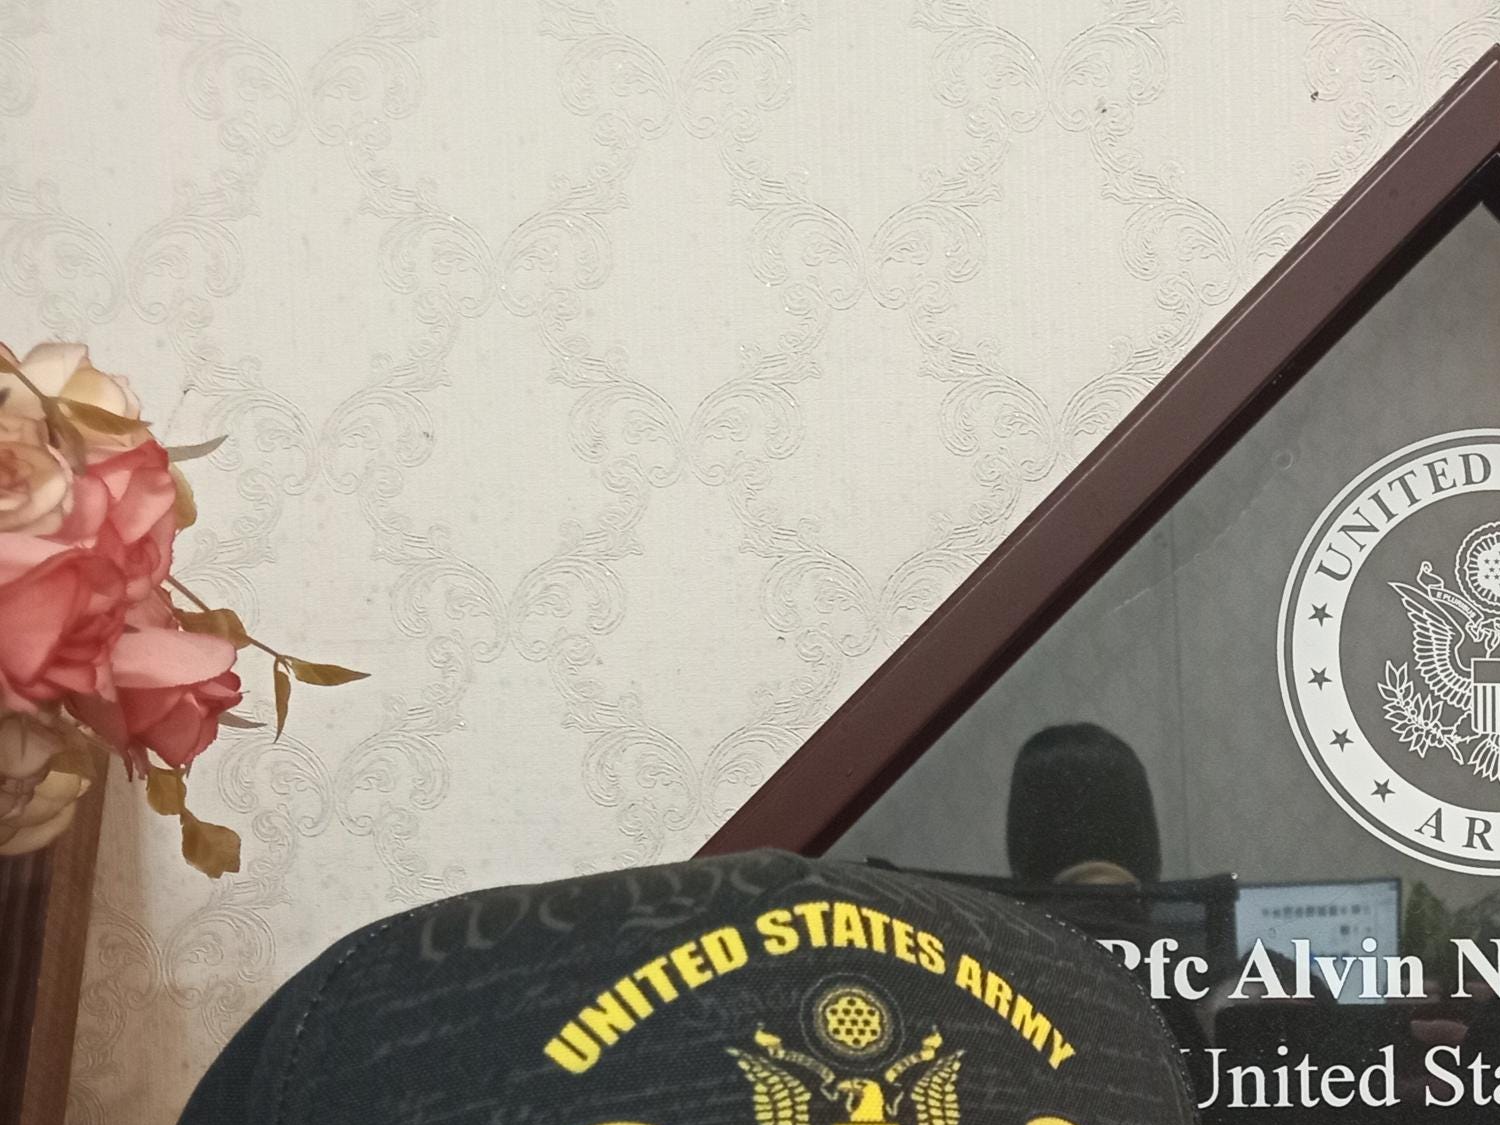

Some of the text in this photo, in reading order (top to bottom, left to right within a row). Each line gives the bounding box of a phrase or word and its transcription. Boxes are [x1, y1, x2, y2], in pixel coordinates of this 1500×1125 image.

[1315, 452, 1491, 581] UNITED
[544, 926, 749, 1073] UNITED
[755, 900, 948, 975] STATES
[953, 953, 1075, 1070] ARMY
[1227, 937, 1428, 1000] Alvin
